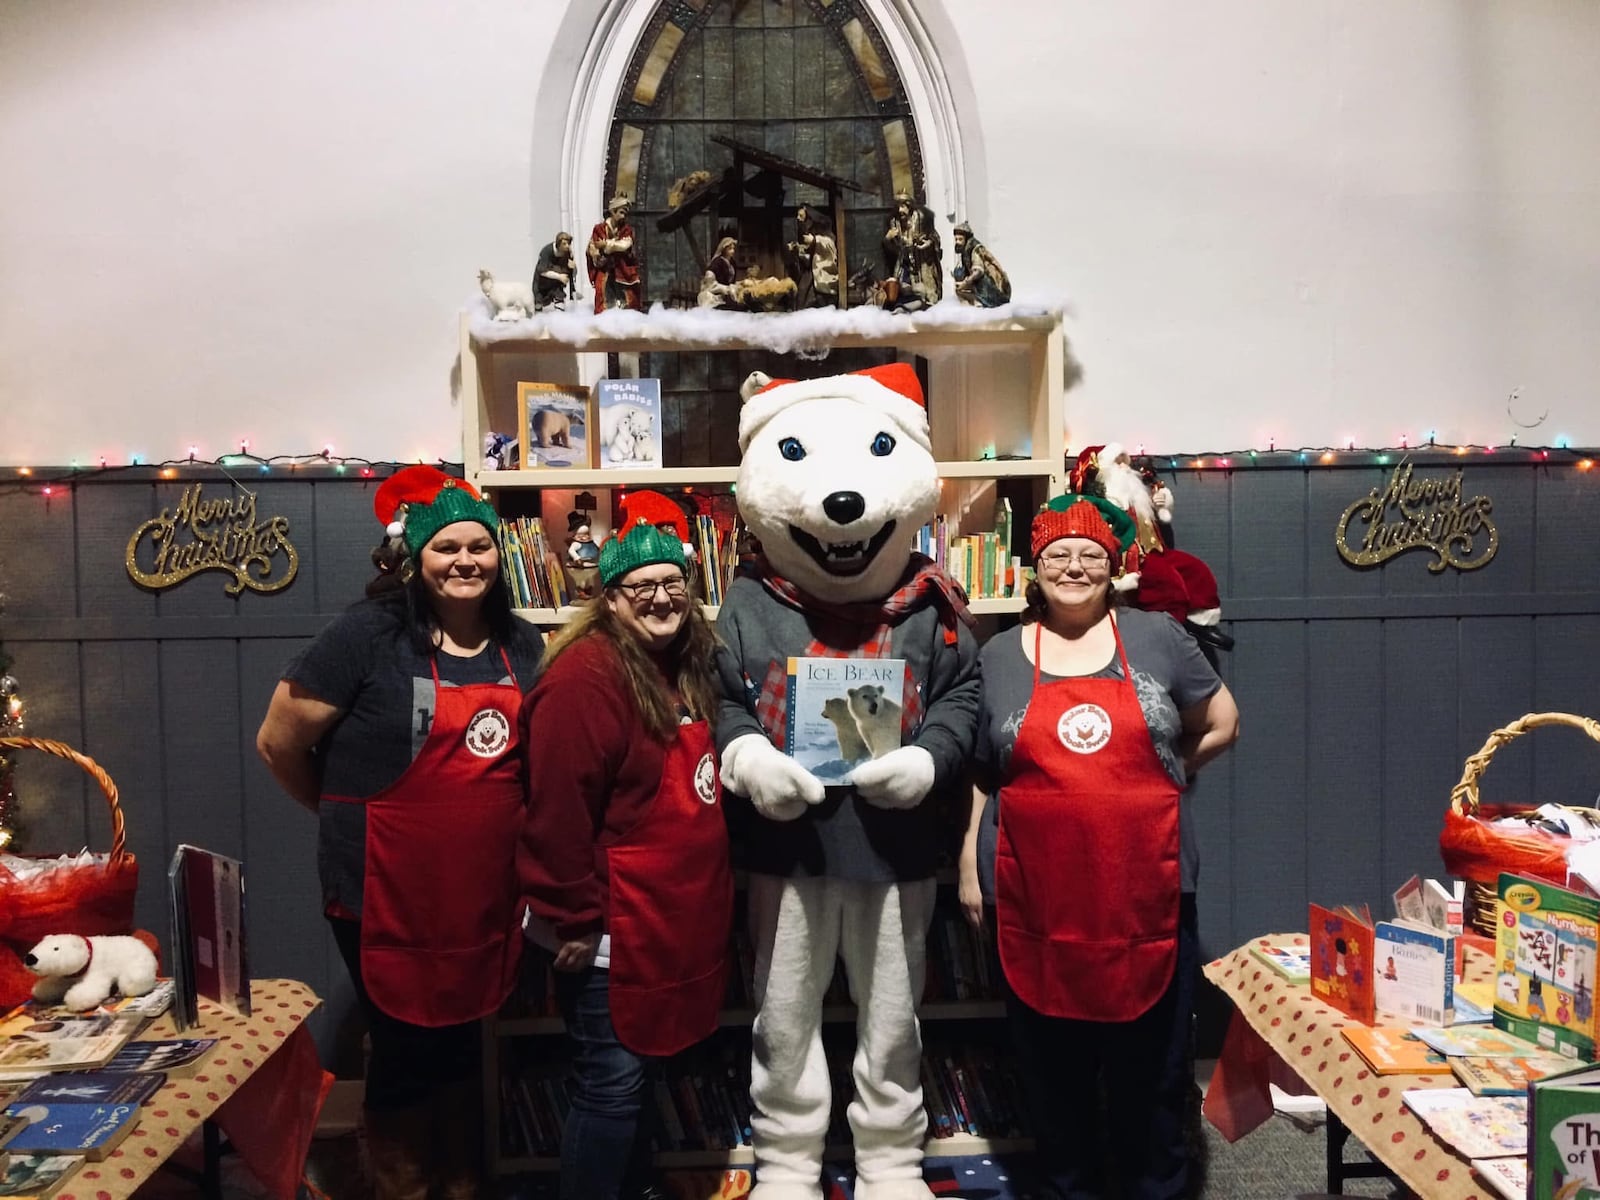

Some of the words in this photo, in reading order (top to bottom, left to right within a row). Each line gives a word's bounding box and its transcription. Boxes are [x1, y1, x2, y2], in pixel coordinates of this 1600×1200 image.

[604, 383, 639, 392] POLAR
[614, 393, 652, 406] BABIES
[1380, 463, 1463, 512] Merry
[173, 483, 257, 530] Merry
[1336, 490, 1498, 574] Christmas
[126, 512, 297, 594] Christmas
[807, 664, 837, 681] ICE
[845, 665, 893, 681] BEAR
[470, 712, 490, 731] Polar
[491, 711, 506, 729] Bear
[1063, 707, 1086, 726] Polar
[1088, 705, 1107, 723] Bear
[468, 736, 487, 753] Book
[488, 735, 507, 753] Swap
[1062, 730, 1084, 749] Book
[1086, 729, 1109, 749] Swap
[1546, 911, 1597, 938] Numbers
[1567, 1150, 1587, 1164] of
